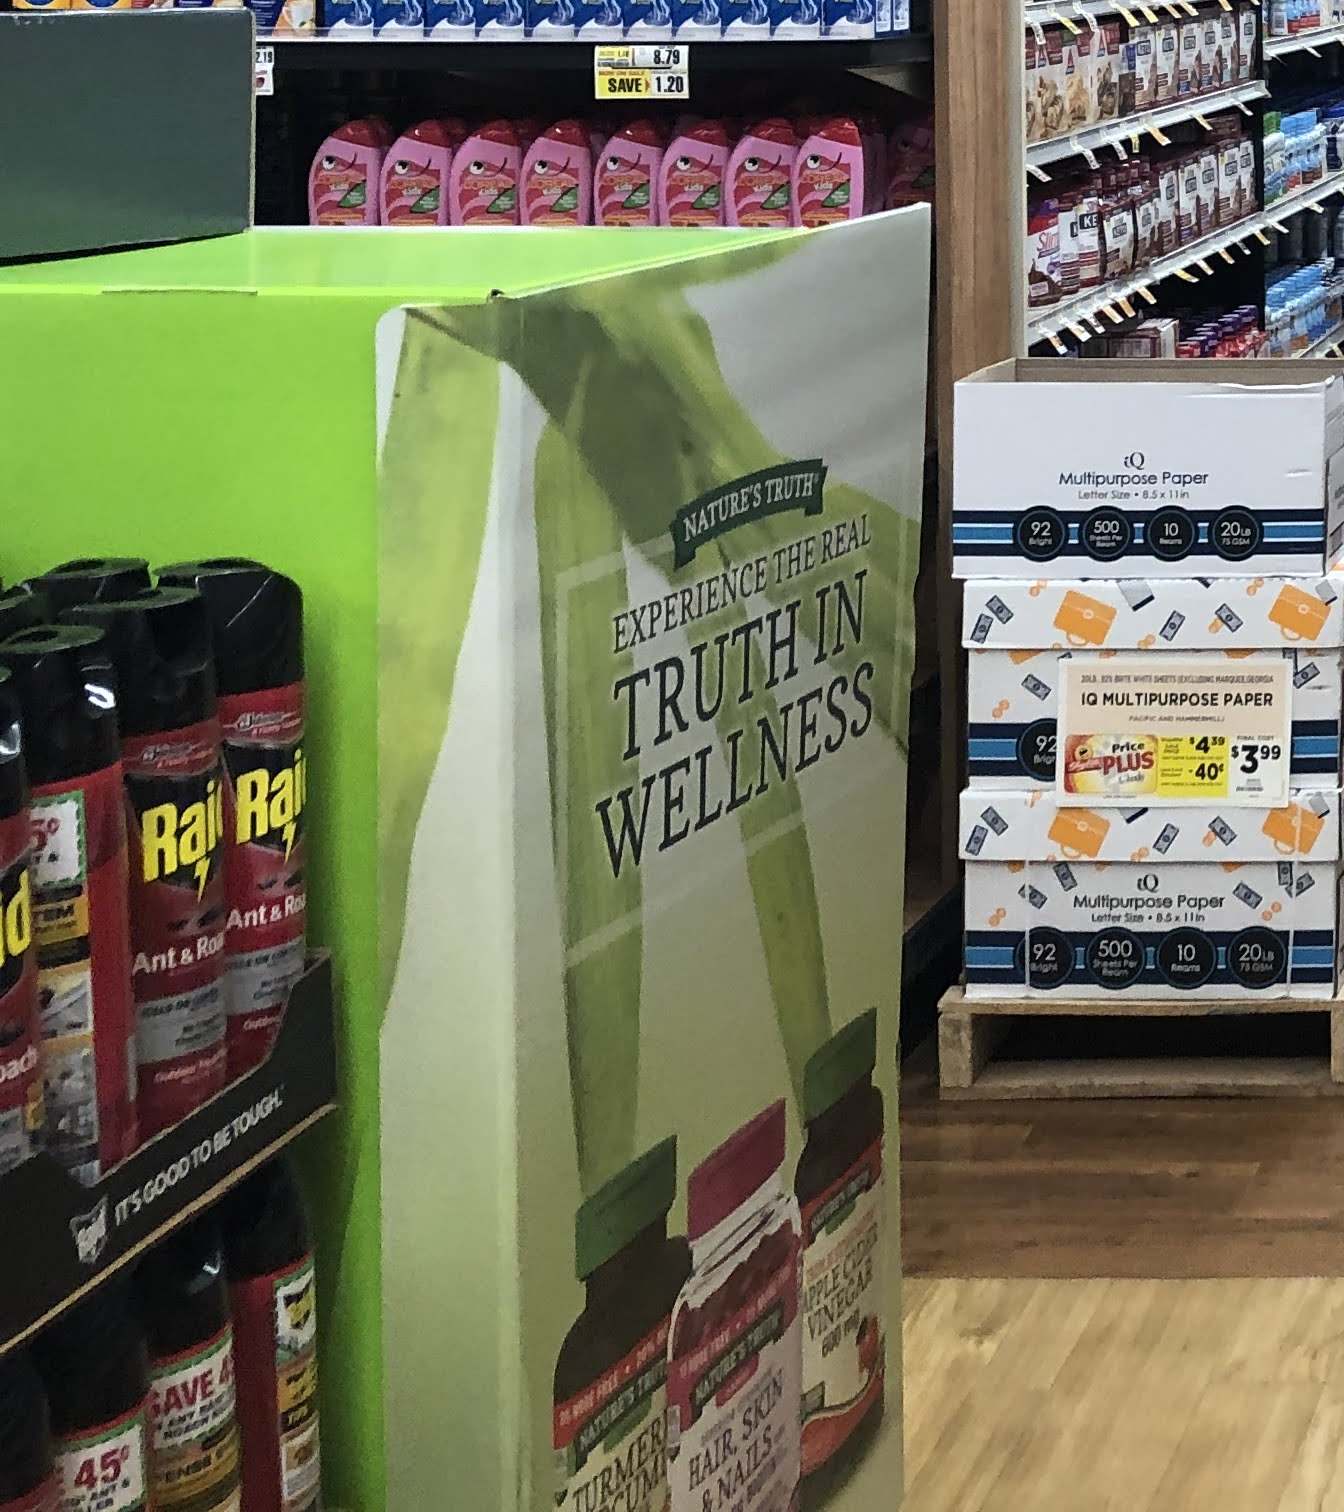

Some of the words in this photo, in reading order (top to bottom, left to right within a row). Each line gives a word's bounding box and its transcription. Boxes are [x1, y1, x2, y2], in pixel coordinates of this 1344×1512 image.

[255, 51, 272, 64] 2.19
[653, 49, 680, 64] 8.79
[608, 77, 642, 93] SAVE
[655, 75, 684, 93] 1.20
[1058, 471, 1157, 489] Multipurpose
[1162, 472, 1209, 489] Paper
[1078, 490, 1108, 500] Letter
[1111, 489, 1131, 500] Size
[1142, 489, 1158, 500] 8.5
[1169, 489, 1190, 500] 11in
[683, 479, 762, 543] NATURE'S
[764, 471, 815, 506] TRUTH
[1030, 522, 1051, 536] 92
[1093, 520, 1120, 534] 500
[1163, 522, 1179, 537] 10
[1028, 537, 1053, 547] Bright
[1232, 538, 1250, 546] GSM
[613, 555, 766, 655] EXPERIENCE
[772, 535, 816, 585] THE
[820, 514, 873, 565] REAL
[613, 600, 802, 762] TRUTH
[813, 569, 868, 666] IN
[1154, 675, 1176, 683] SHEETS
[1081, 692, 1097, 706] IQ
[1103, 692, 1218, 707] MULTIPURPOSE
[1223, 692, 1273, 707] PAPER
[1036, 735, 1057, 753] 92
[1111, 741, 1145, 754] Price
[594, 661, 874, 880] WELLNESS
[1102, 751, 1155, 774] PLUS
[1072, 894, 1174, 912] Multipurpose
[1176, 894, 1226, 912] Paper
[226, 900, 267, 930] Ant
[270, 904, 282, 923] &
[1091, 913, 1122, 923] Letter
[1124, 912, 1144, 923] Size
[1156, 913, 1172, 923] 8.5
[1174, 915, 1181, 923] x
[1033, 943, 1056, 961] 92
[1098, 939, 1133, 958] 500
[1177, 944, 1196, 962] 10
[132, 947, 177, 976] Ant
[181, 946, 194, 966] &
[1093, 959, 1123, 969] Sheets
[1124, 959, 1139, 968] Per
[1170, 963, 1201, 973] Reams
[1252, 962, 1273, 972] GSM
[1102, 967, 1130, 979] Ream
[114, 1190, 141, 1227] IT'S
[142, 1155, 190, 1206] GOOD
[190, 1139, 212, 1171] TO
[211, 1126, 233, 1155] BE
[231, 1086, 285, 1142] TOUGH.
[807, 1259, 873, 1341] VINEGAR
[149, 1371, 213, 1417] SAVE
[688, 1425, 738, 1492] HAIR,
[741, 1375, 783, 1437] SKIN
[716, 1423, 775, 1510] NAILS
